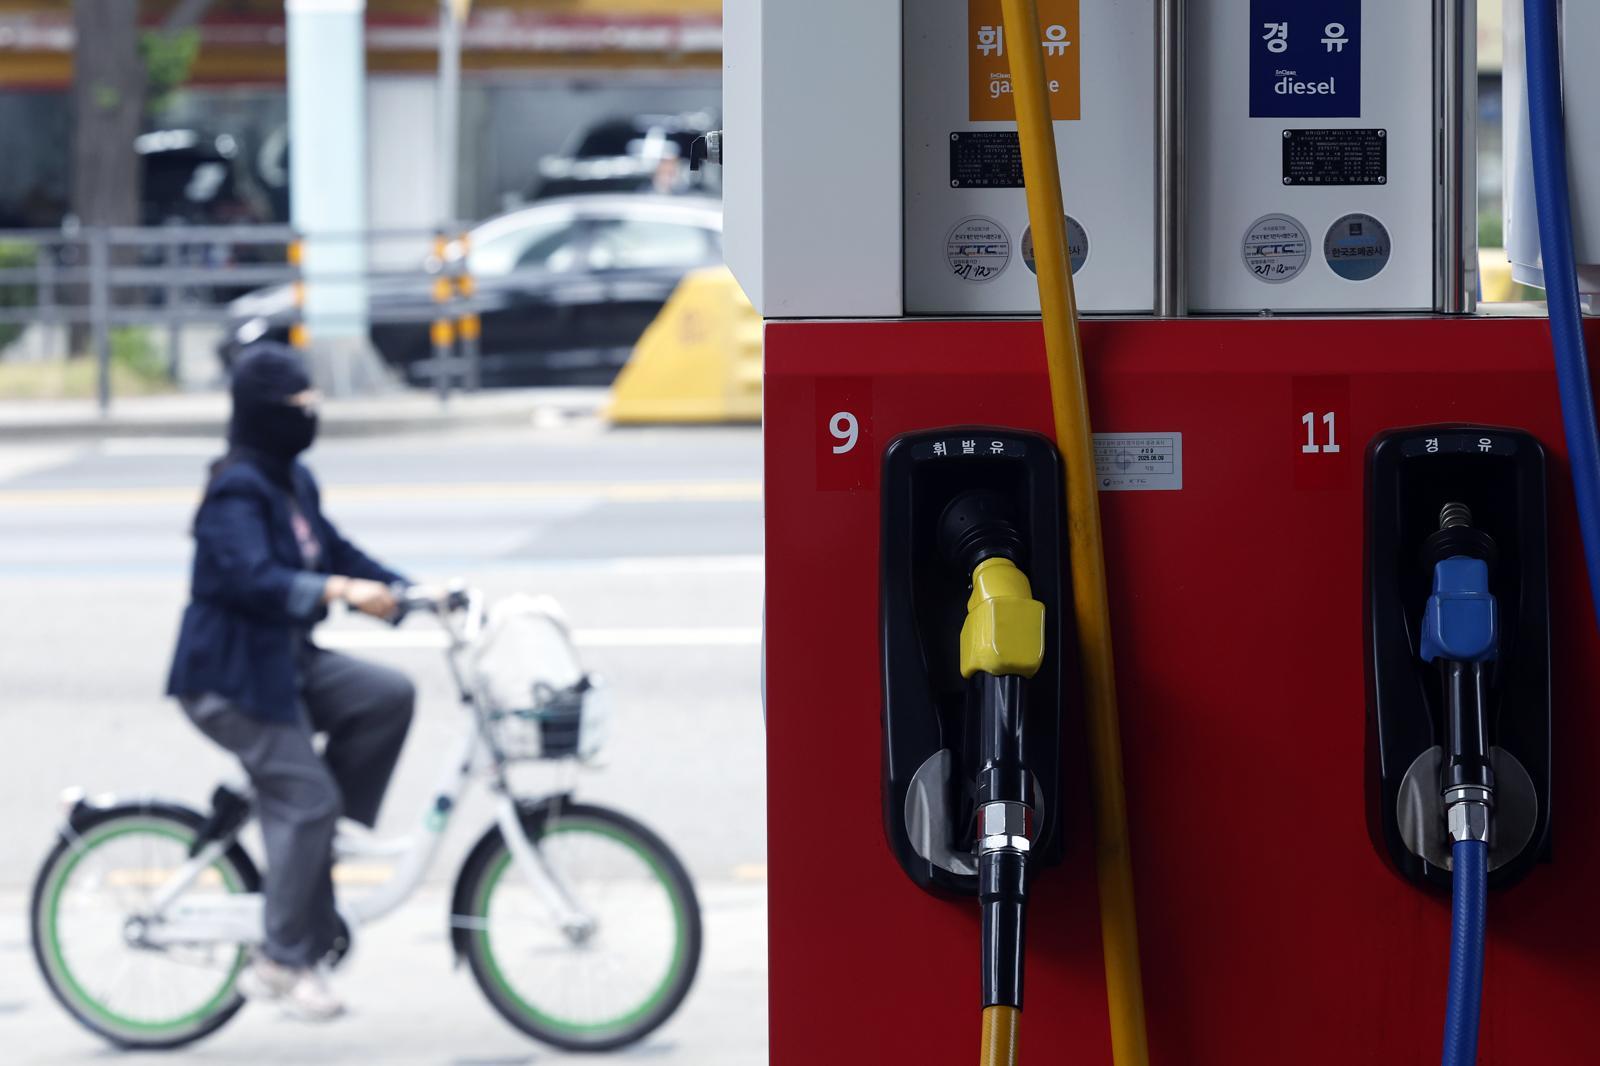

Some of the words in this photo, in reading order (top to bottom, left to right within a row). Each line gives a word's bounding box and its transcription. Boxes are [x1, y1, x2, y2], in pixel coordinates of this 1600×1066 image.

[1274, 76, 1336, 95] diesel
[959, 244, 997, 256] KTC
[1256, 243, 1295, 257] KTC
[954, 263, 973, 280] 27
[974, 265, 991, 277] 12
[1254, 264, 1271, 276] 27
[1276, 263, 1286, 274] 12
[829, 411, 859, 454] 9
[1302, 411, 1340, 454] 11
